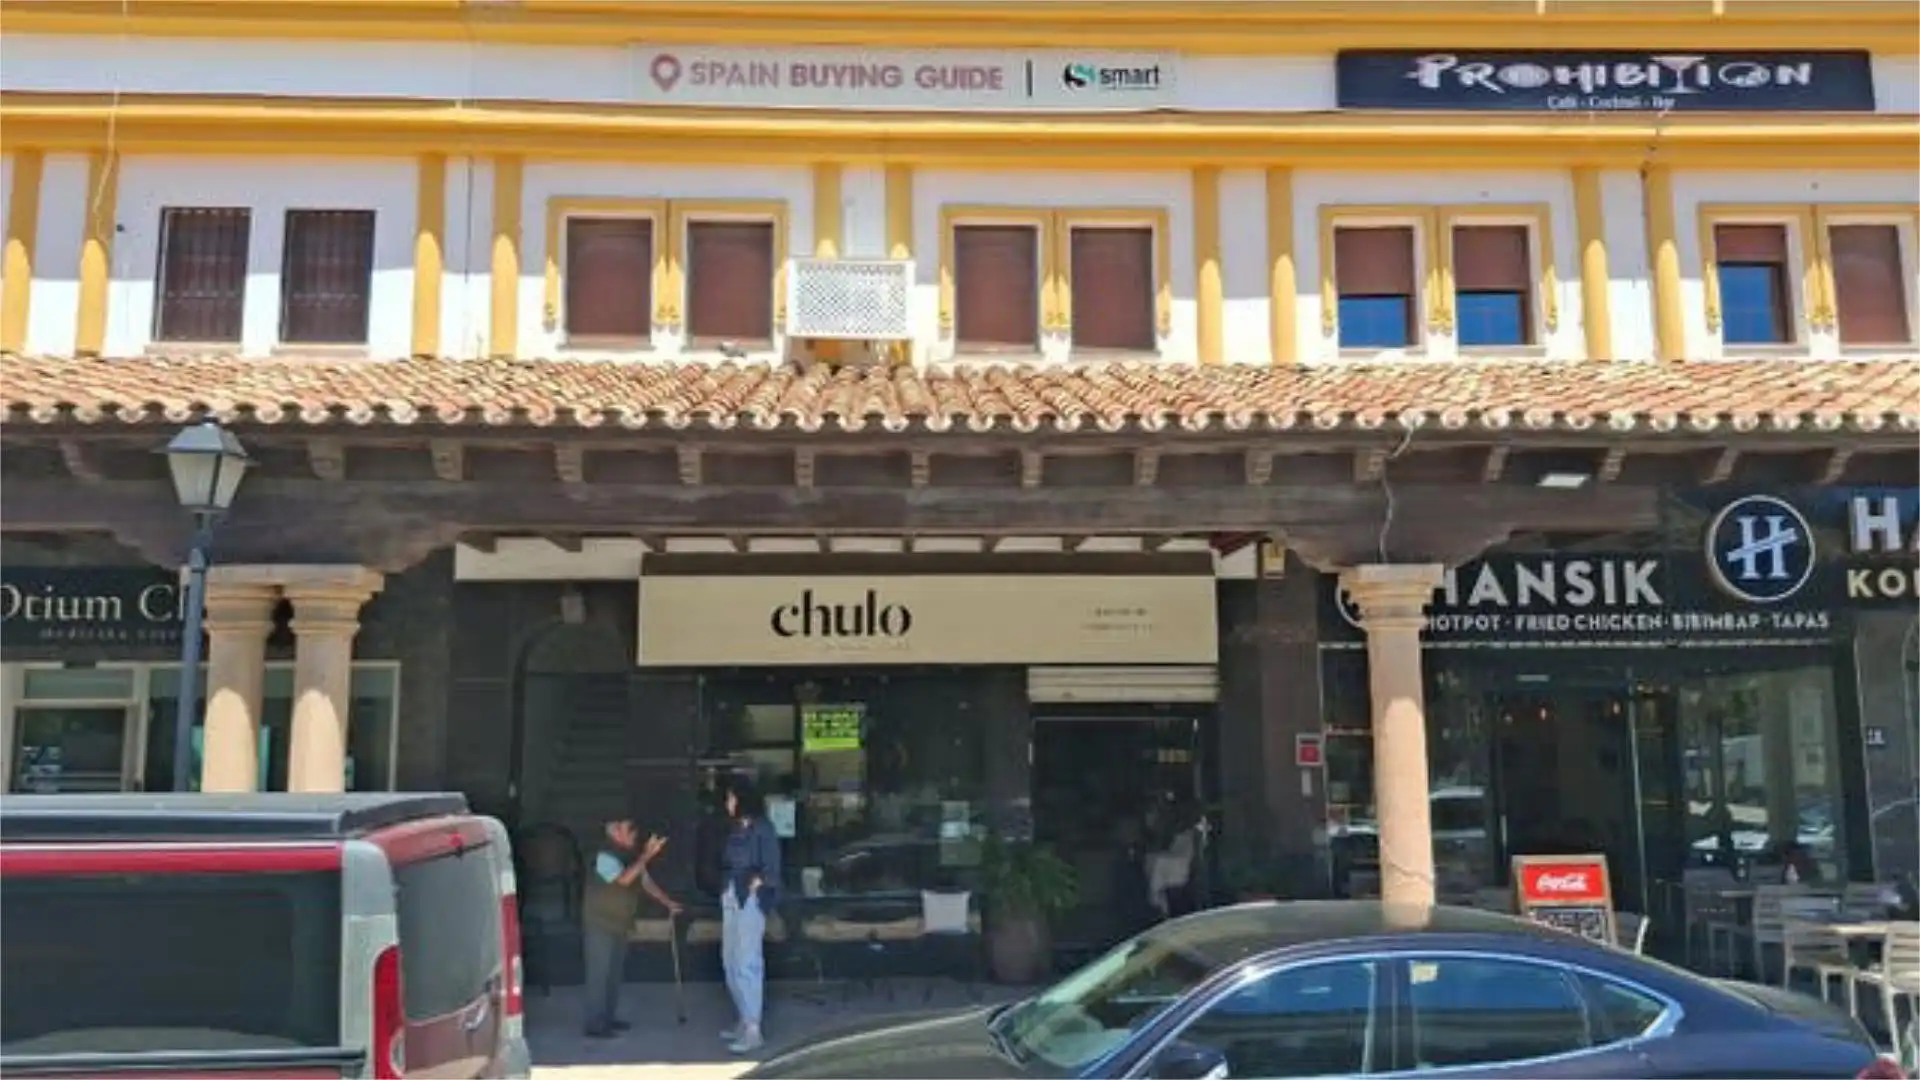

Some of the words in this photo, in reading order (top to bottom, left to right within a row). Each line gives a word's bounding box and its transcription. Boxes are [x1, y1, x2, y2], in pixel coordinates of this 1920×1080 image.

[690, 61, 779, 87] SPAIN
[790, 64, 902, 88] BUYING
[915, 65, 1004, 90] GUIDE
[1100, 65, 1159, 85] smart
[1850, 497, 1920, 551] H
[1846, 567, 1920, 598] KO
[138, 584, 185, 622] Cl
[770, 588, 912, 637] chulo
[1515, 614, 1569, 632] FRIED
[1574, 613, 1662, 632] CHICKEN
[1672, 612, 1759, 632] BIBIMBAP
[1772, 610, 1829, 629] TAPAS
